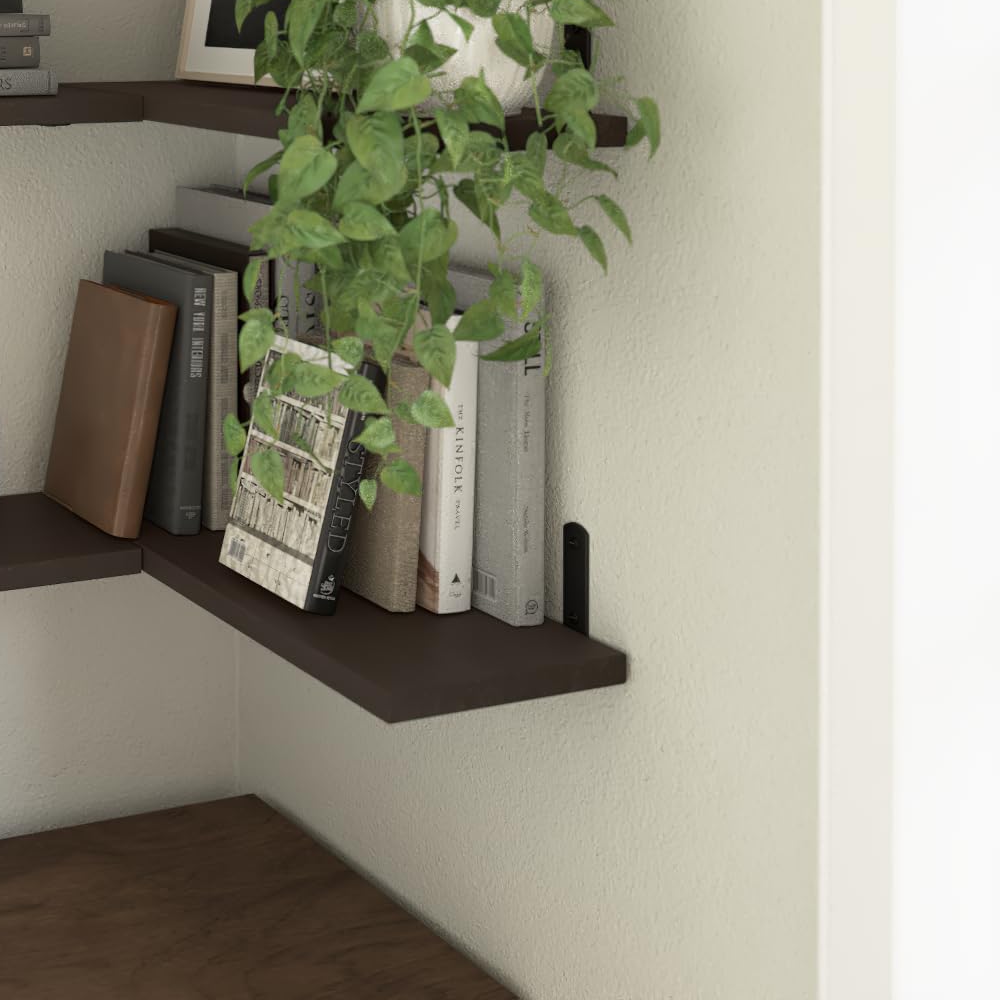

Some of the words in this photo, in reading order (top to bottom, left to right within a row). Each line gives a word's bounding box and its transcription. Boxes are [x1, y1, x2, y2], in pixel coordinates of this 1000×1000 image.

[194, 287, 207, 306] NEW
[453, 426, 465, 494] KINFOLK
[328, 440, 366, 552] STYLED
